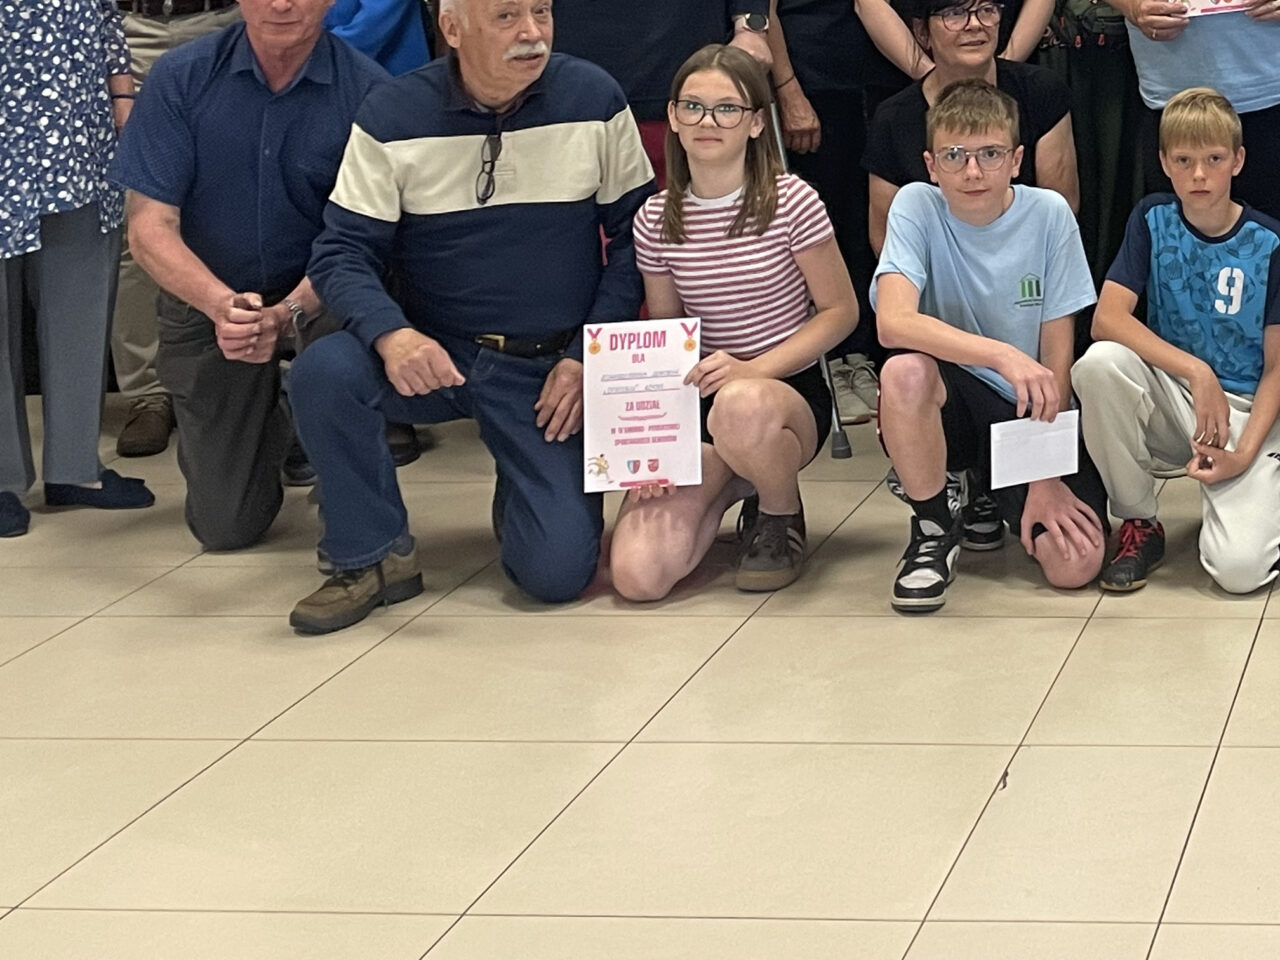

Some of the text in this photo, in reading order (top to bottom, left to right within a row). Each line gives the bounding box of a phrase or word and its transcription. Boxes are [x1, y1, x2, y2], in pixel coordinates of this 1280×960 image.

[1214, 266, 1244, 315] 9
[610, 331, 666, 351] DYPLOM
[632, 353, 645, 364] DLA
[625, 401, 634, 411] ZA
